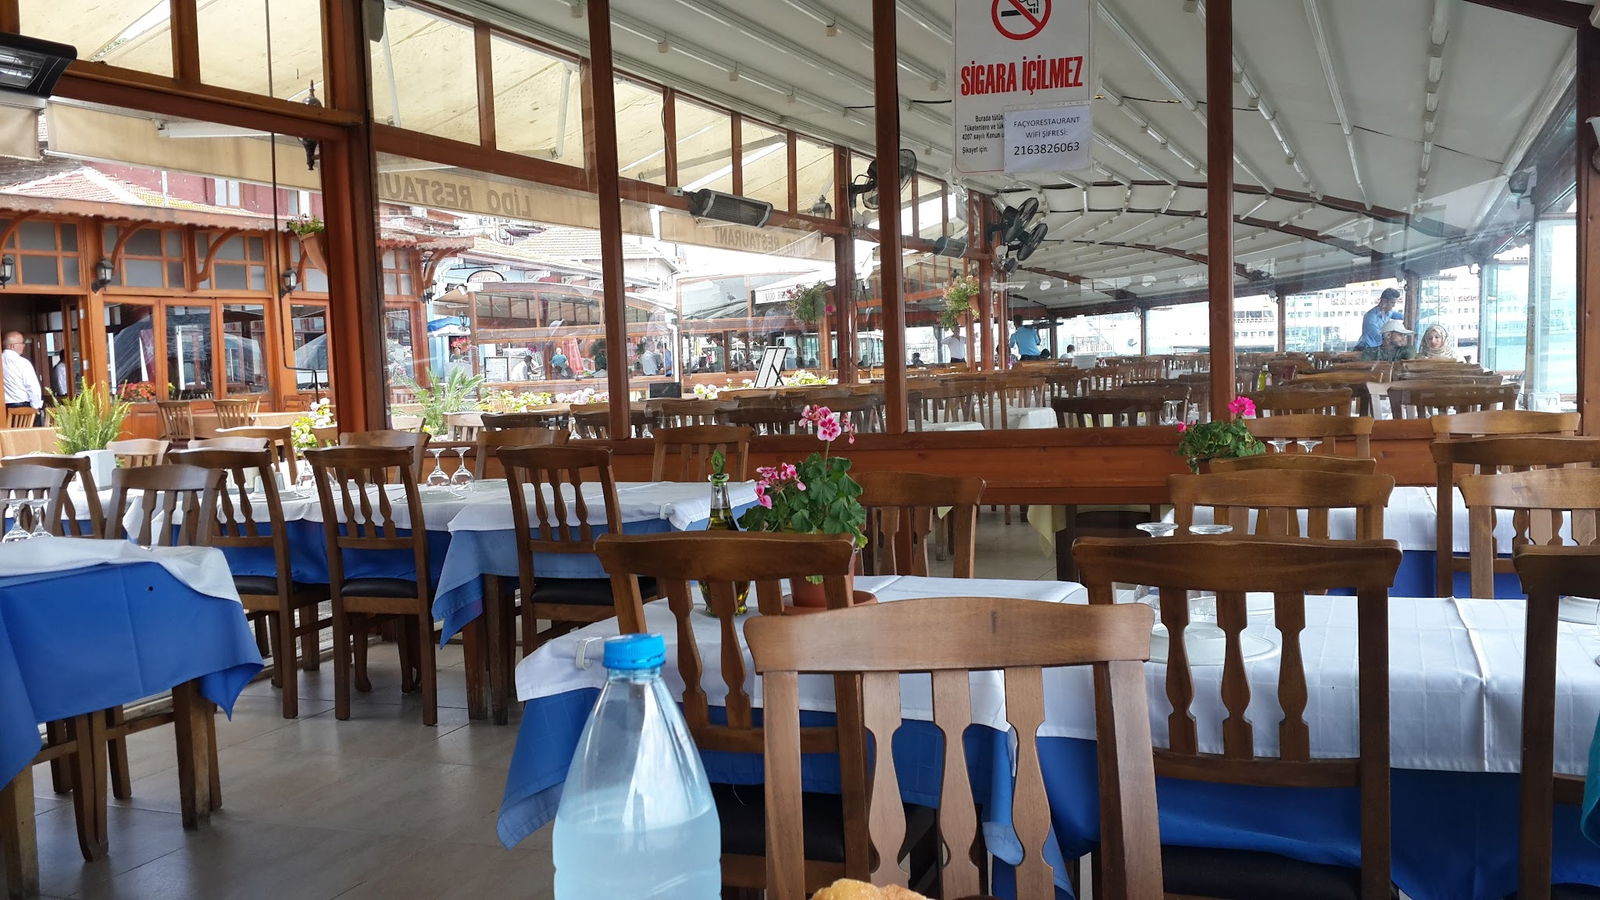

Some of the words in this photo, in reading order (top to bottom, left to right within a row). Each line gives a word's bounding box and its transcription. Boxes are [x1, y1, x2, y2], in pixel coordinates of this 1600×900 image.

[961, 60, 1017, 96] SİGARA
[1022, 55, 1083, 95] İÇİLMEZ
[1013, 141, 1080, 156] 2163826063
